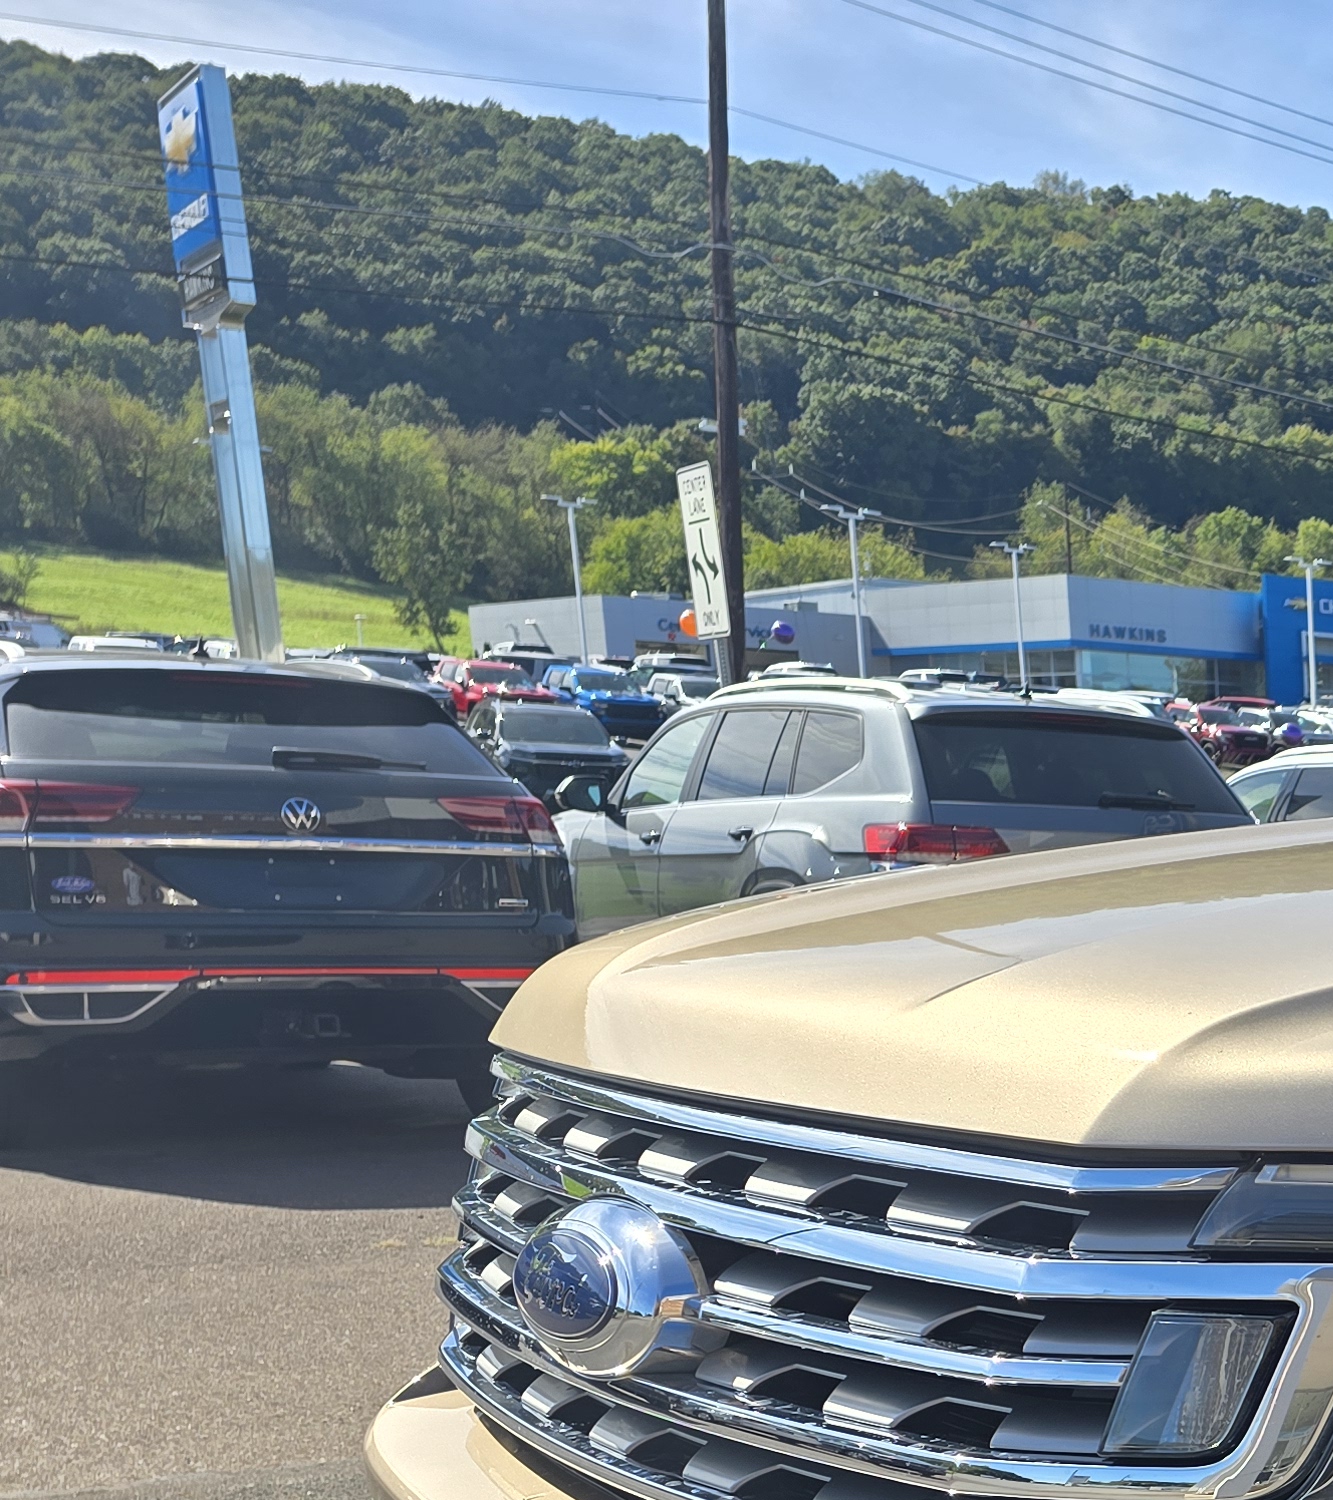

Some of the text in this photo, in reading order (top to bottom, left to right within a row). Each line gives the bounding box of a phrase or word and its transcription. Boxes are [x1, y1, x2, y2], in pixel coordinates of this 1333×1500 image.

[683, 475, 706, 495] CENTER
[688, 497, 706, 516] LANE
[702, 609, 720, 627] ONLY
[1088, 623, 1167, 643] HAWKINS
[50, 893, 107, 904] SEL V6
